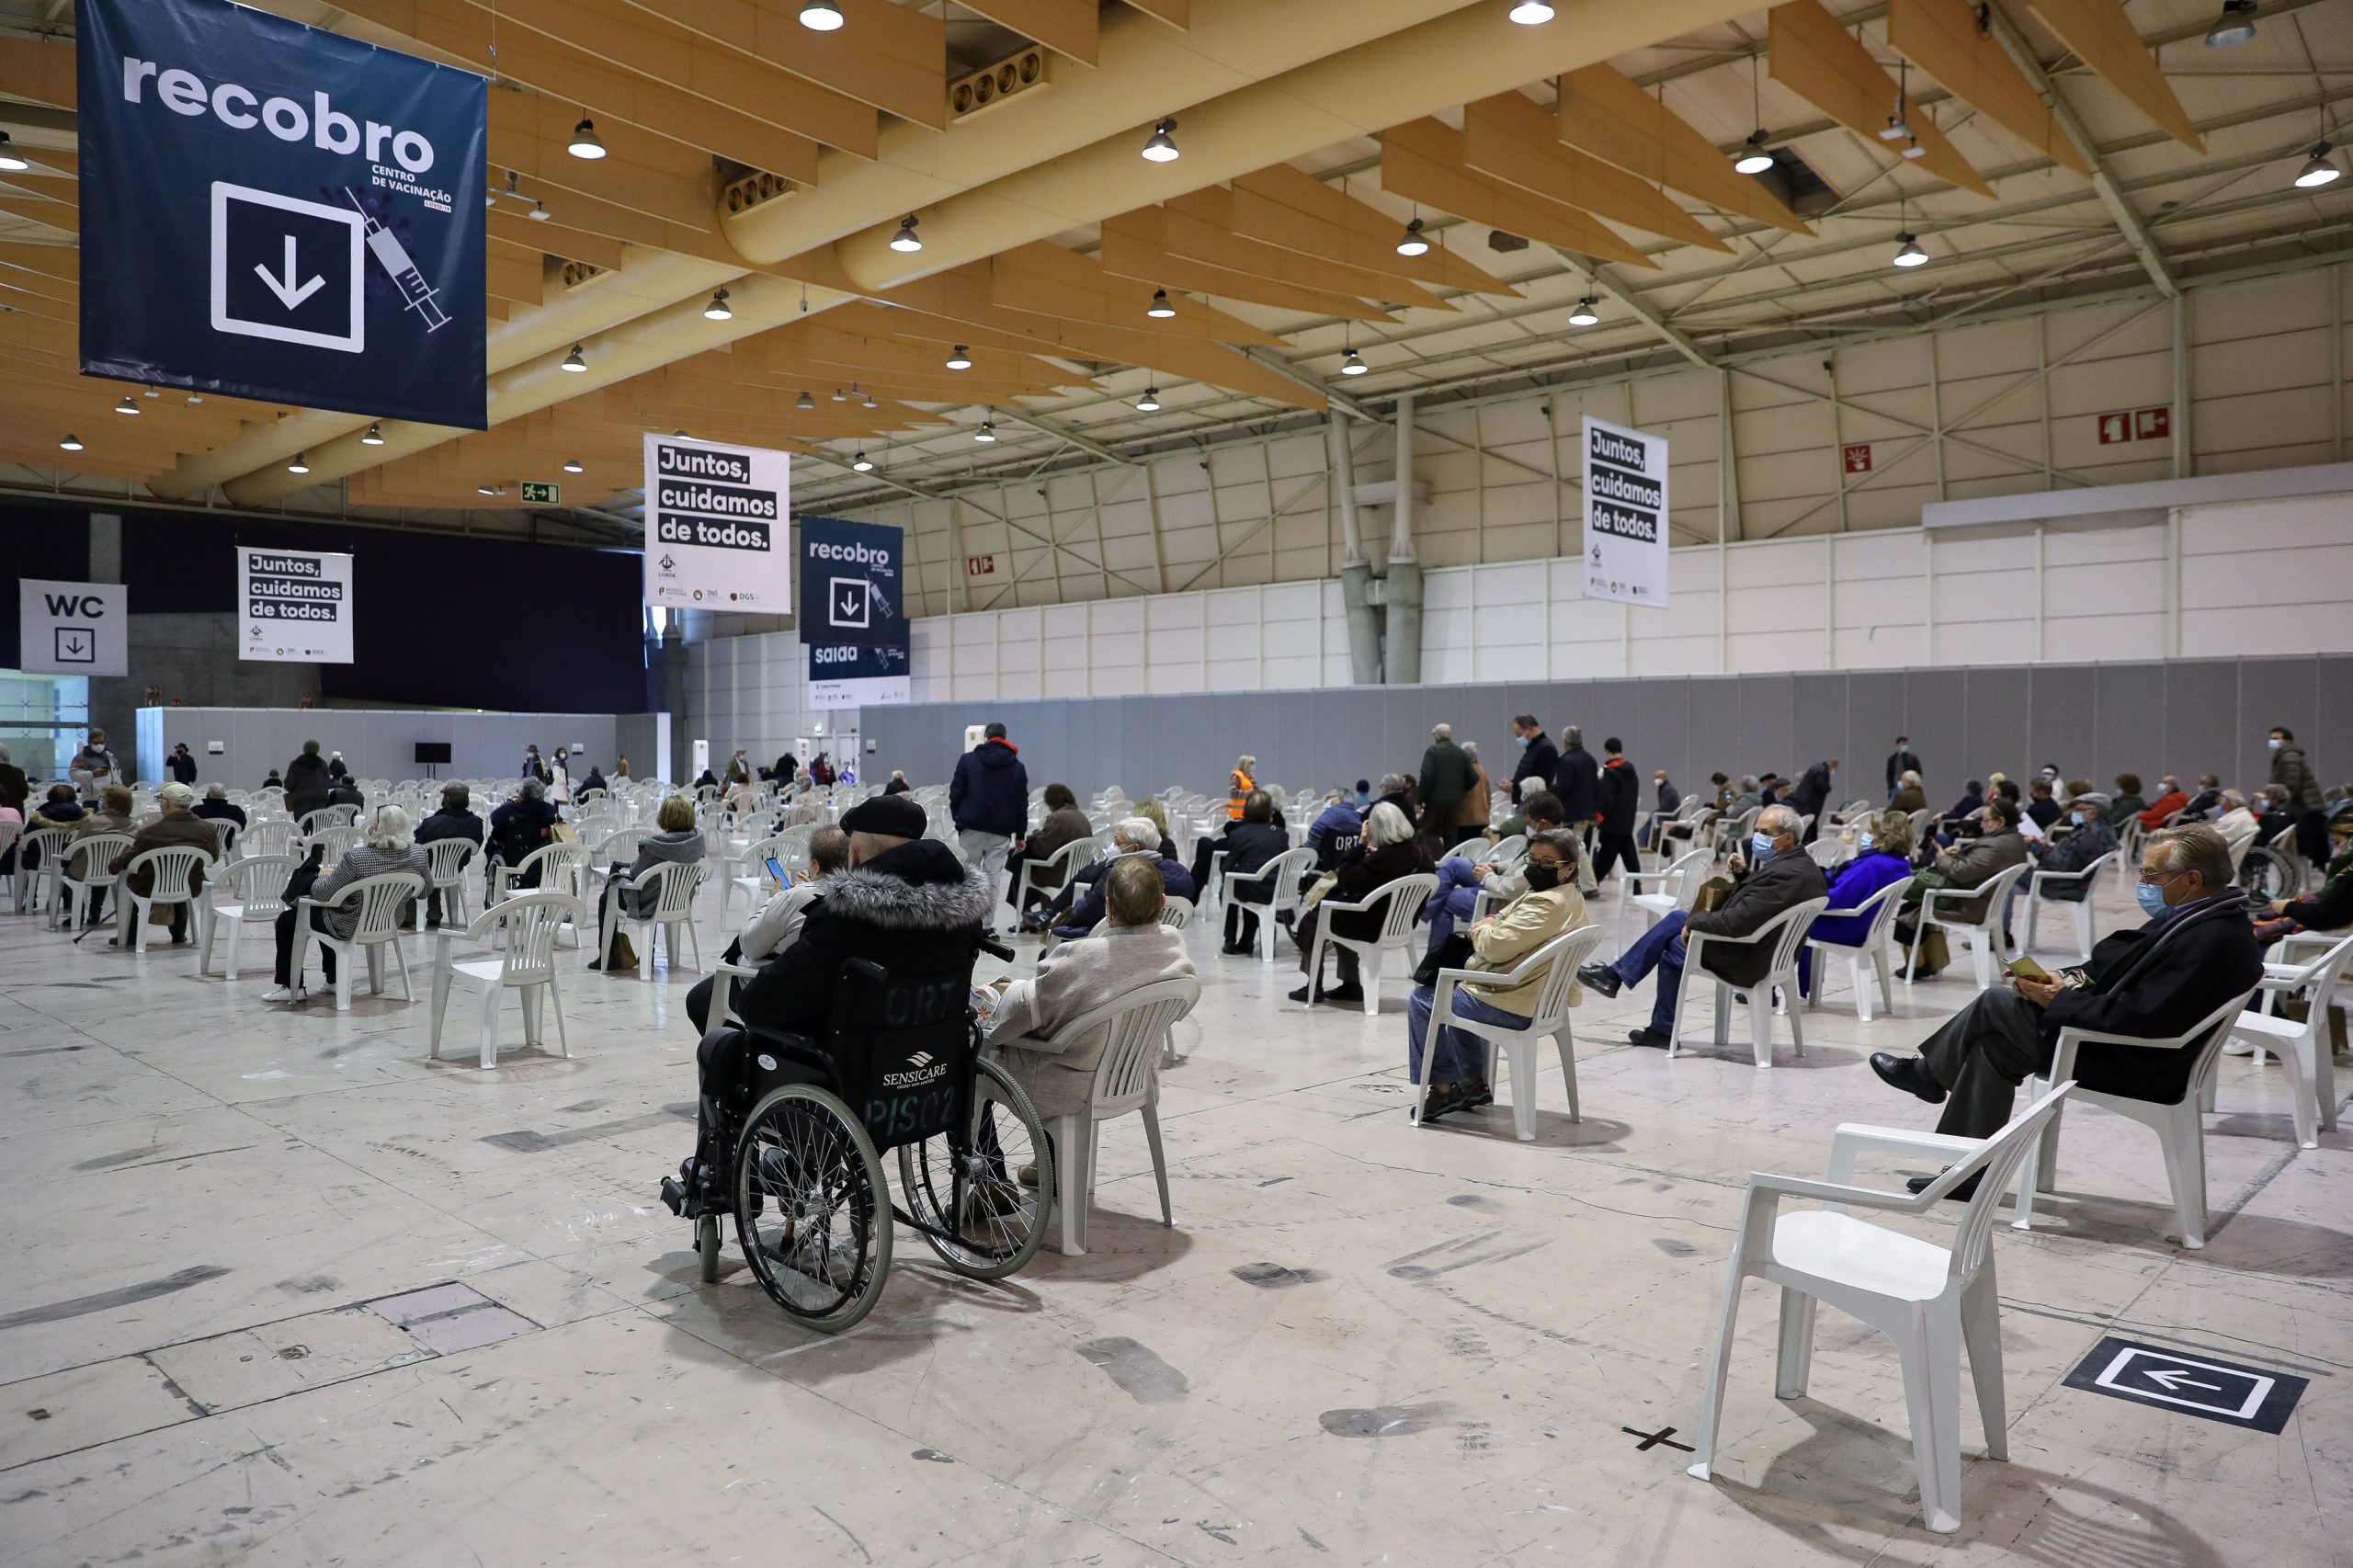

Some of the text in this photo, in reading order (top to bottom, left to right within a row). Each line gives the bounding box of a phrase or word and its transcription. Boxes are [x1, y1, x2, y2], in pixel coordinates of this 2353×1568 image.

[123, 56, 434, 173] recobro
[371, 165, 415, 182] CENTRO
[371, 176, 451, 203] DE VACINAÇÃO
[426, 200, 450, 211] COVID-19
[1592, 431, 1644, 470] Juntos,
[660, 448, 748, 482] Juntos,
[661, 486, 775, 517] cuidamos
[1592, 472, 1661, 506] cuidamos
[660, 517, 768, 548] de todos.
[1593, 504, 1656, 540] de todos.
[251, 555, 320, 576] Juntos,
[810, 541, 890, 564] recobro
[251, 581, 341, 599] cuidamos
[45, 594, 104, 619] WC
[251, 601, 336, 620] de todos.
[882, 1062, 947, 1086] SENSICARE
